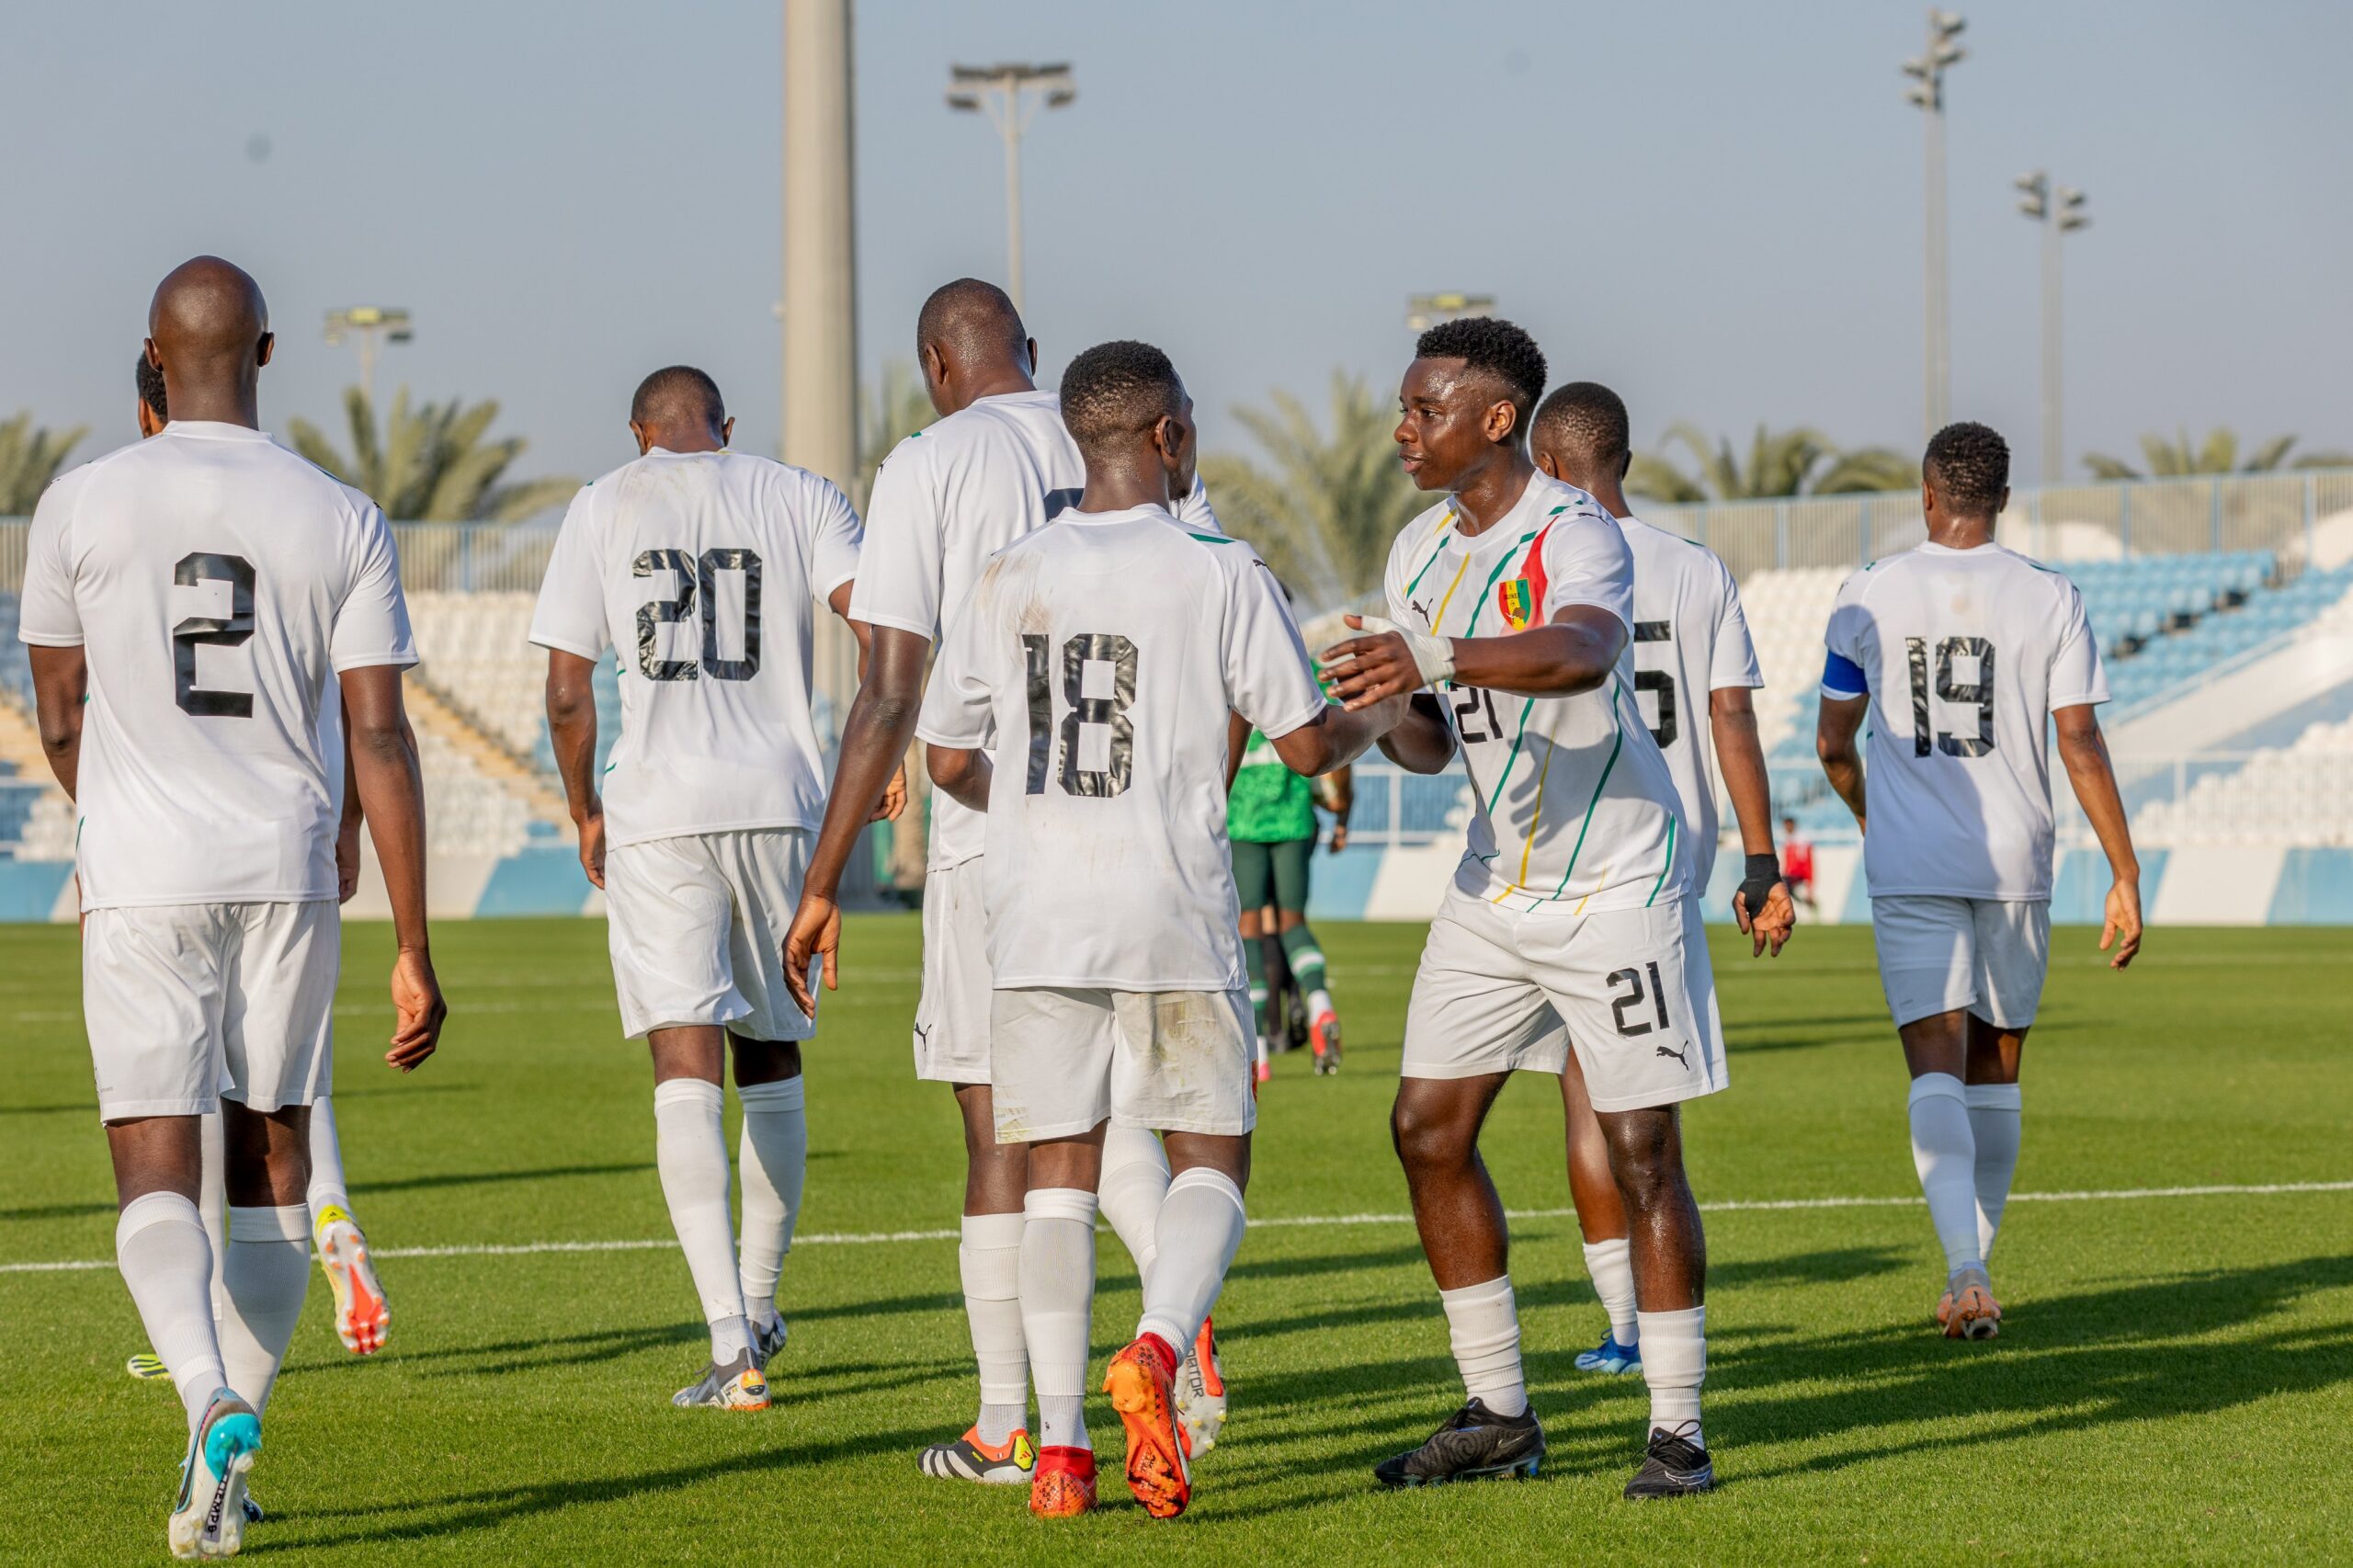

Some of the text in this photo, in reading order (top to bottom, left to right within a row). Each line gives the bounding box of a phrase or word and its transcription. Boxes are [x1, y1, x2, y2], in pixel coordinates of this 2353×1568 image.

[173, 551, 256, 719] 2
[632, 548, 762, 681] 20
[1021, 633, 1139, 798] 18
[1449, 681, 1504, 744] 21
[1634, 620, 1678, 749] 5
[1905, 637, 1995, 758] 19
[1606, 960, 1670, 1038] 21
